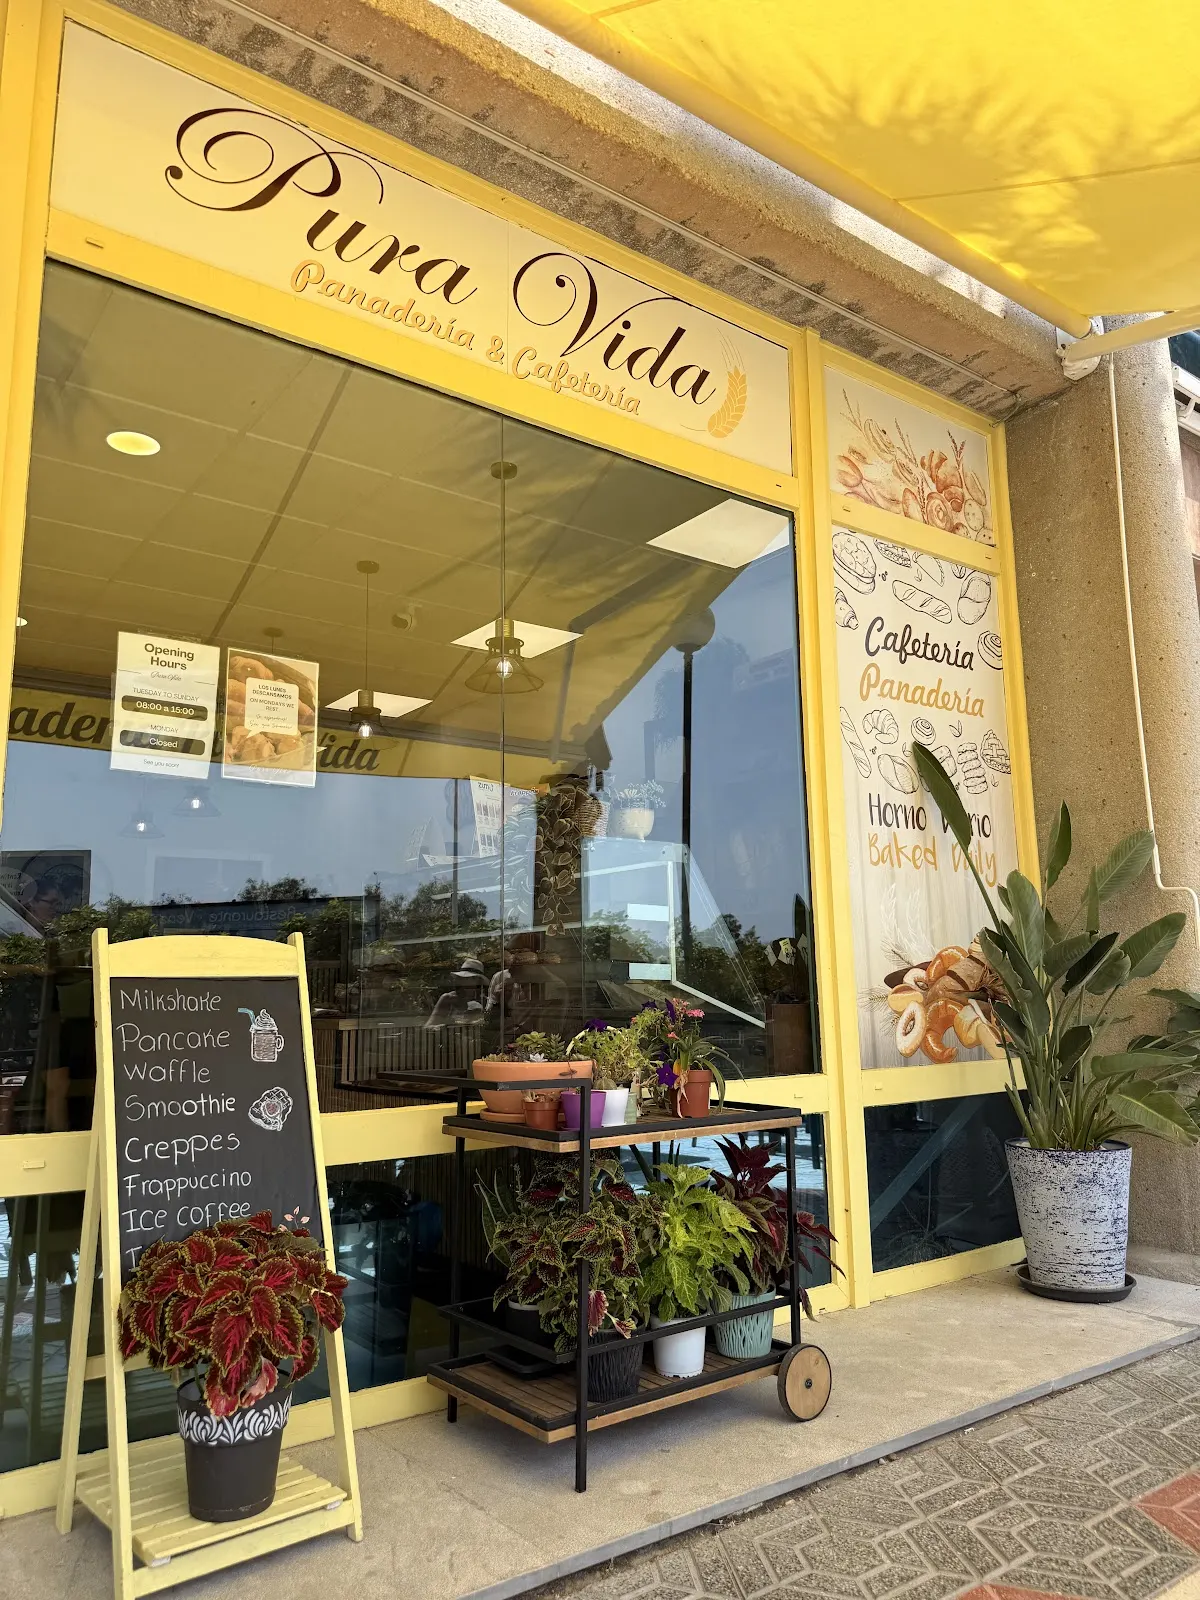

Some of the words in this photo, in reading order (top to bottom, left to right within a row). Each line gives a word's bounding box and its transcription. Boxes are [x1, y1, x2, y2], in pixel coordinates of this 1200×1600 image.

[165, 108, 478, 305] Pura
[512, 252, 716, 405] Vida
[291, 259, 475, 350] Panadería
[486, 335, 504, 365] &
[511, 346, 641, 416] Cafetería
[144, 643, 194, 661] Opening
[864, 616, 974, 671] Cafetería
[150, 656, 187, 670] Hours
[133, 687, 162, 696] TUESDAY
[174, 693, 200, 702] SUNDAY
[252, 689, 292, 700] DESCANSAMOS
[259, 699, 285, 707] MONDAYS
[859, 662, 984, 718] Panadería
[136, 701, 162, 711] 08:00
[171, 706, 194, 716] 15:00
[149, 737, 178, 748] Closed
[150, 724, 178, 734] MONDAY
[868, 793, 927, 832] Horno
[867, 831, 938, 872] Baked
[119, 988, 222, 1013] Milkshake
[116, 1022, 231, 1052] Pancake
[125, 1093, 236, 1122] Smoothie
[125, 1132, 241, 1165] Creppes
[123, 1168, 252, 1201] Frappuccino
